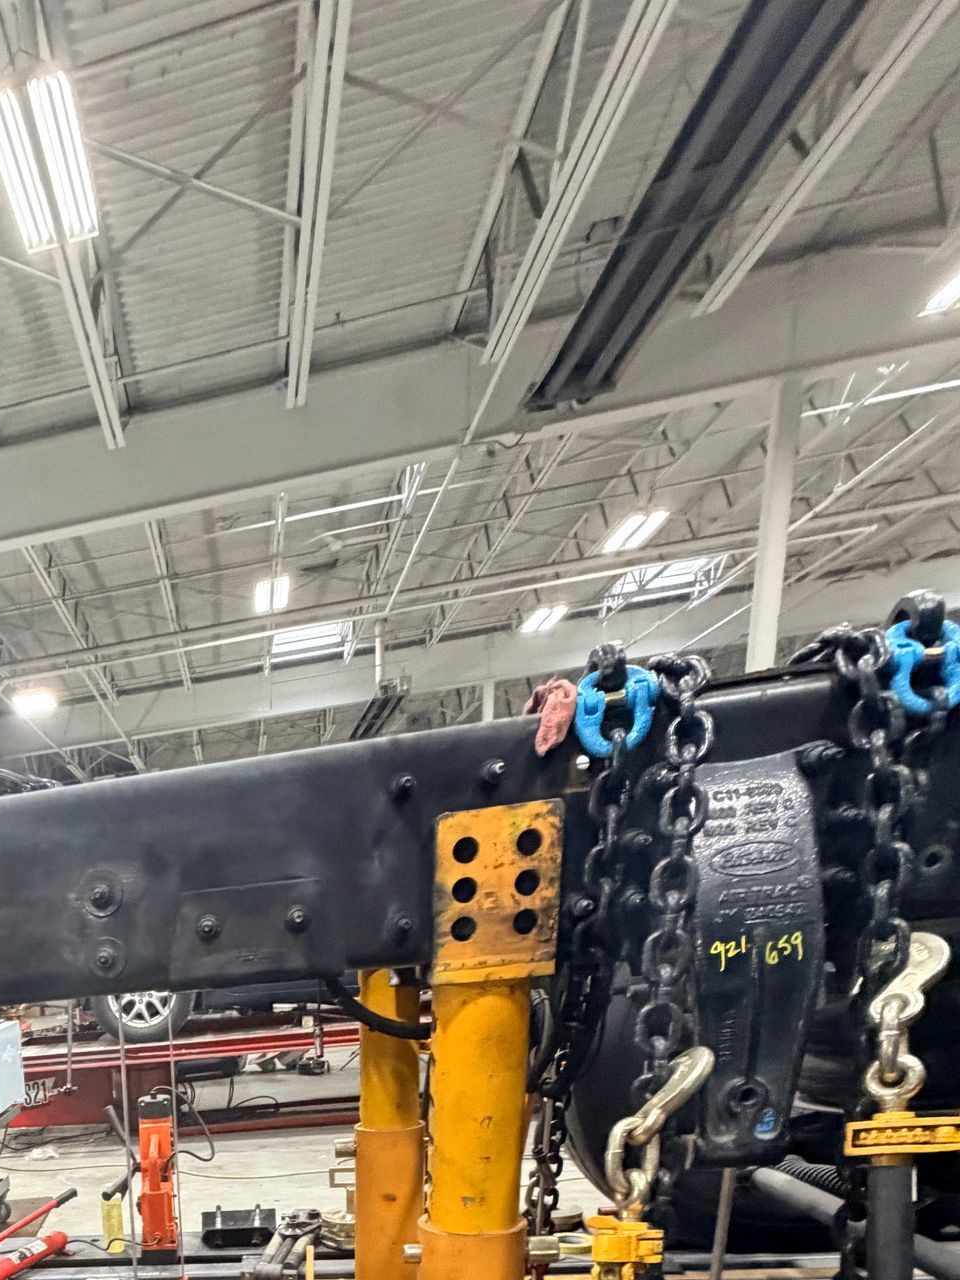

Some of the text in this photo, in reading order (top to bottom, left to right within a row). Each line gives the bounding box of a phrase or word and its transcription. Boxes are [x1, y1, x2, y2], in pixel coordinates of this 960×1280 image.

[710, 935, 747, 972] 921
[765, 931, 803, 965] 659
[24, 1080, 48, 1106] S21
